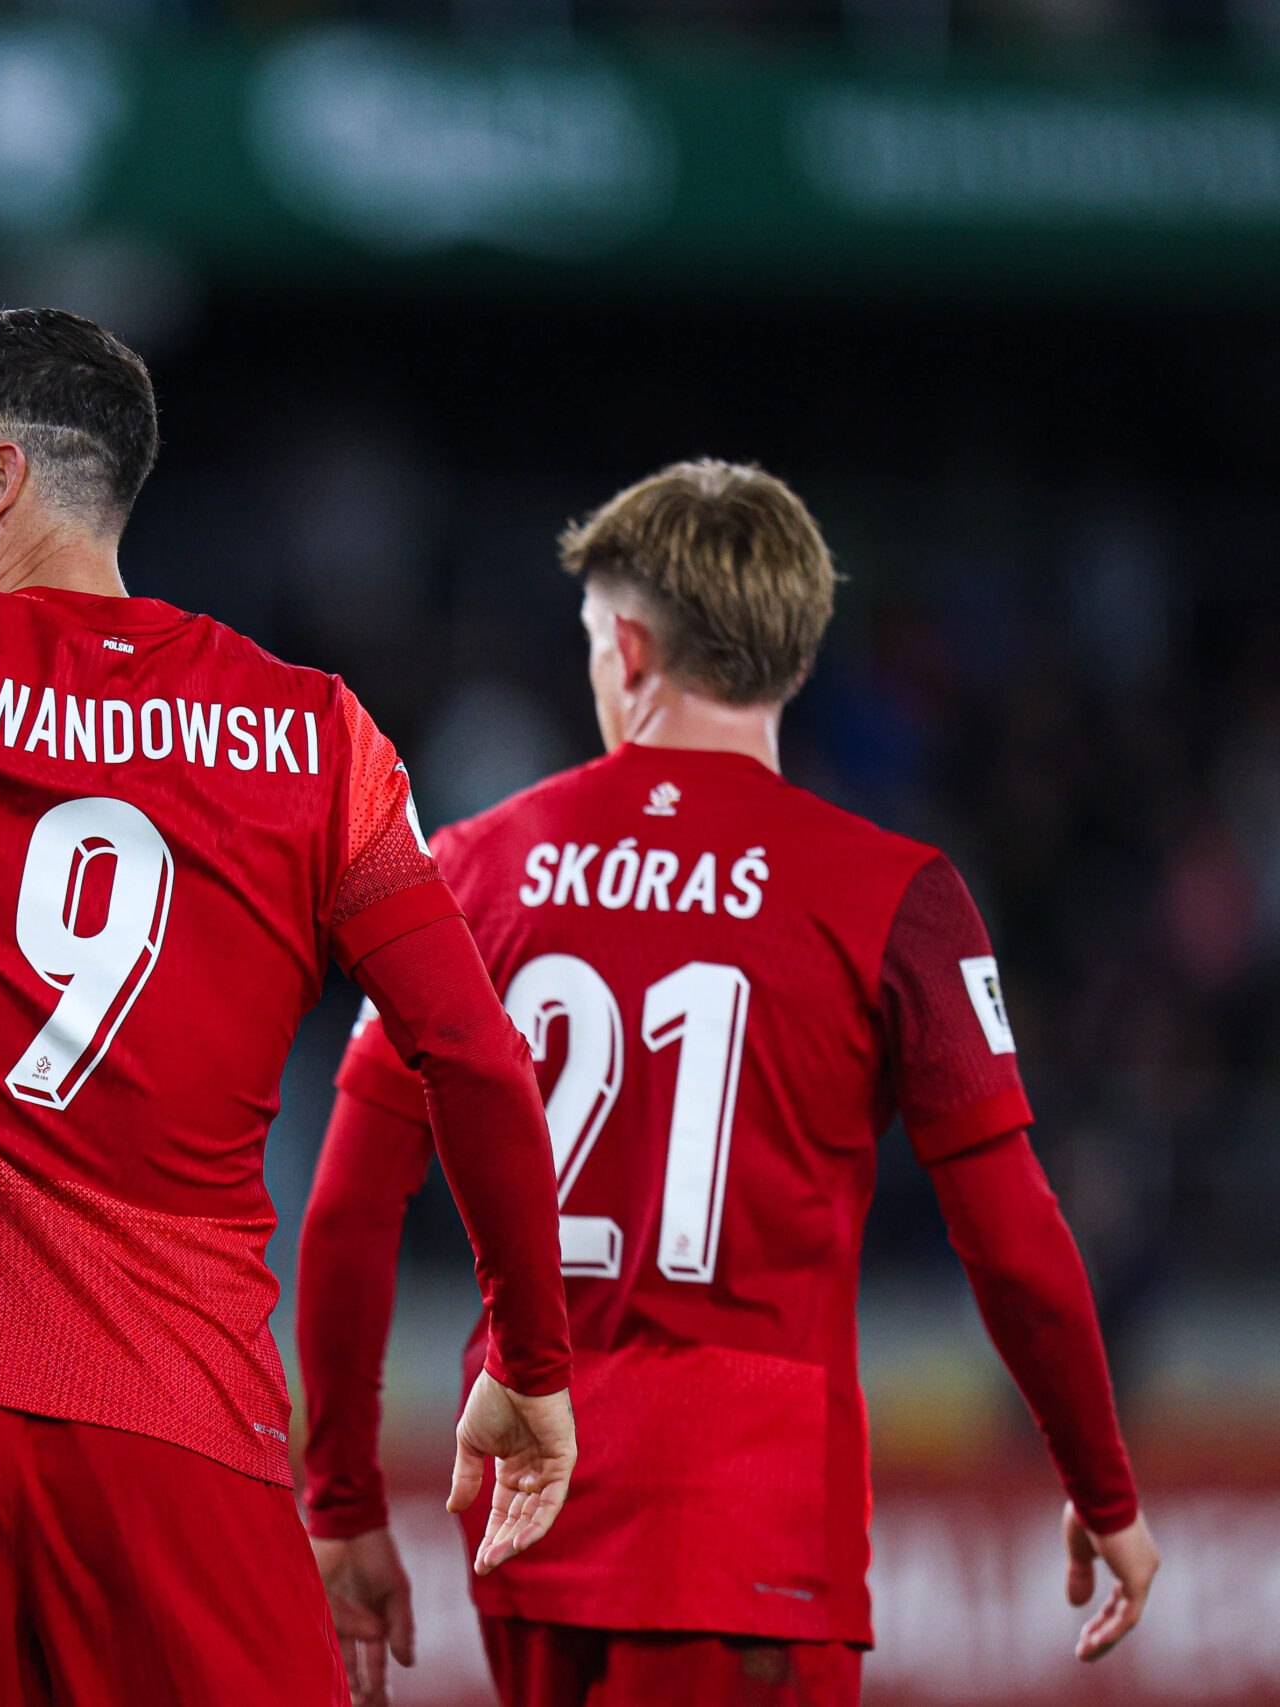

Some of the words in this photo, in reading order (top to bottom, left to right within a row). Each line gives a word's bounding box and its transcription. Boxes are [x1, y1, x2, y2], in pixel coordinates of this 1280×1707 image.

[102, 639, 135, 655] POLSKA
[4, 796, 175, 1111] 9
[519, 836, 770, 920] SKÓRAŚ
[503, 952, 751, 1284] 21
